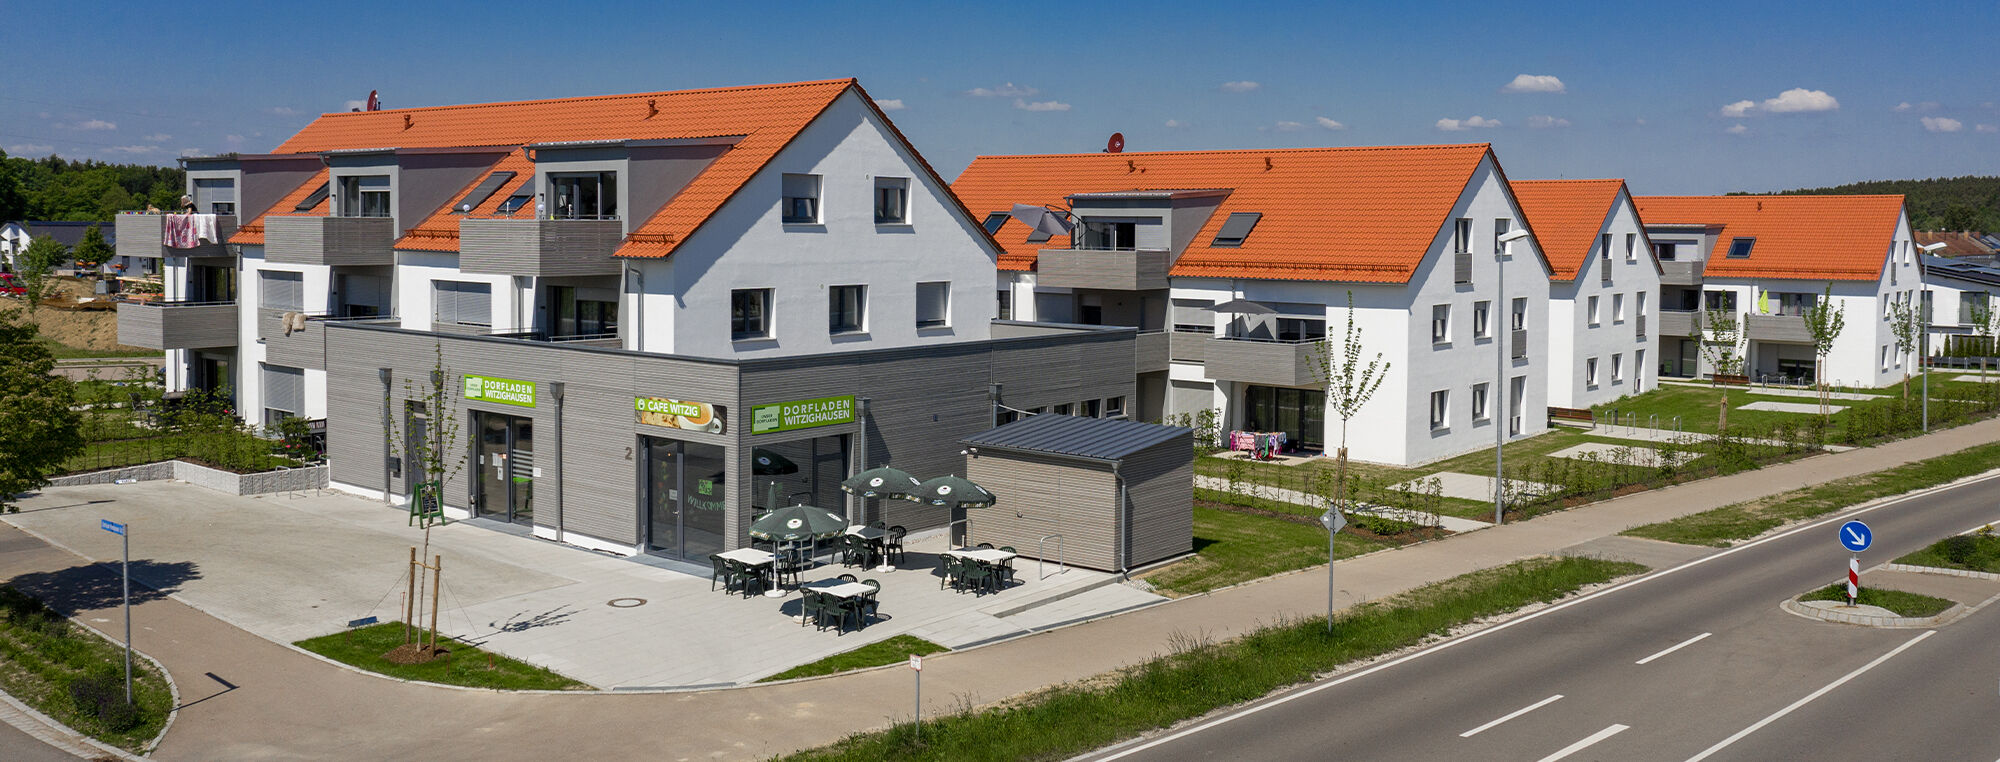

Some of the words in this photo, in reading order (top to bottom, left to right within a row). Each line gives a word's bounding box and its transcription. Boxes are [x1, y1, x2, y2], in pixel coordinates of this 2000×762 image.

[484, 380, 532, 394] DORFLADEN
[484, 389, 533, 403] WITZIGHAUSEN
[647, 401, 668, 412] CAFE
[669, 403, 698, 416] WITZIG
[783, 399, 850, 416] DORFLADEN
[784, 409, 850, 426] WITZIGHAUSEN
[625, 446, 633, 460] 2
